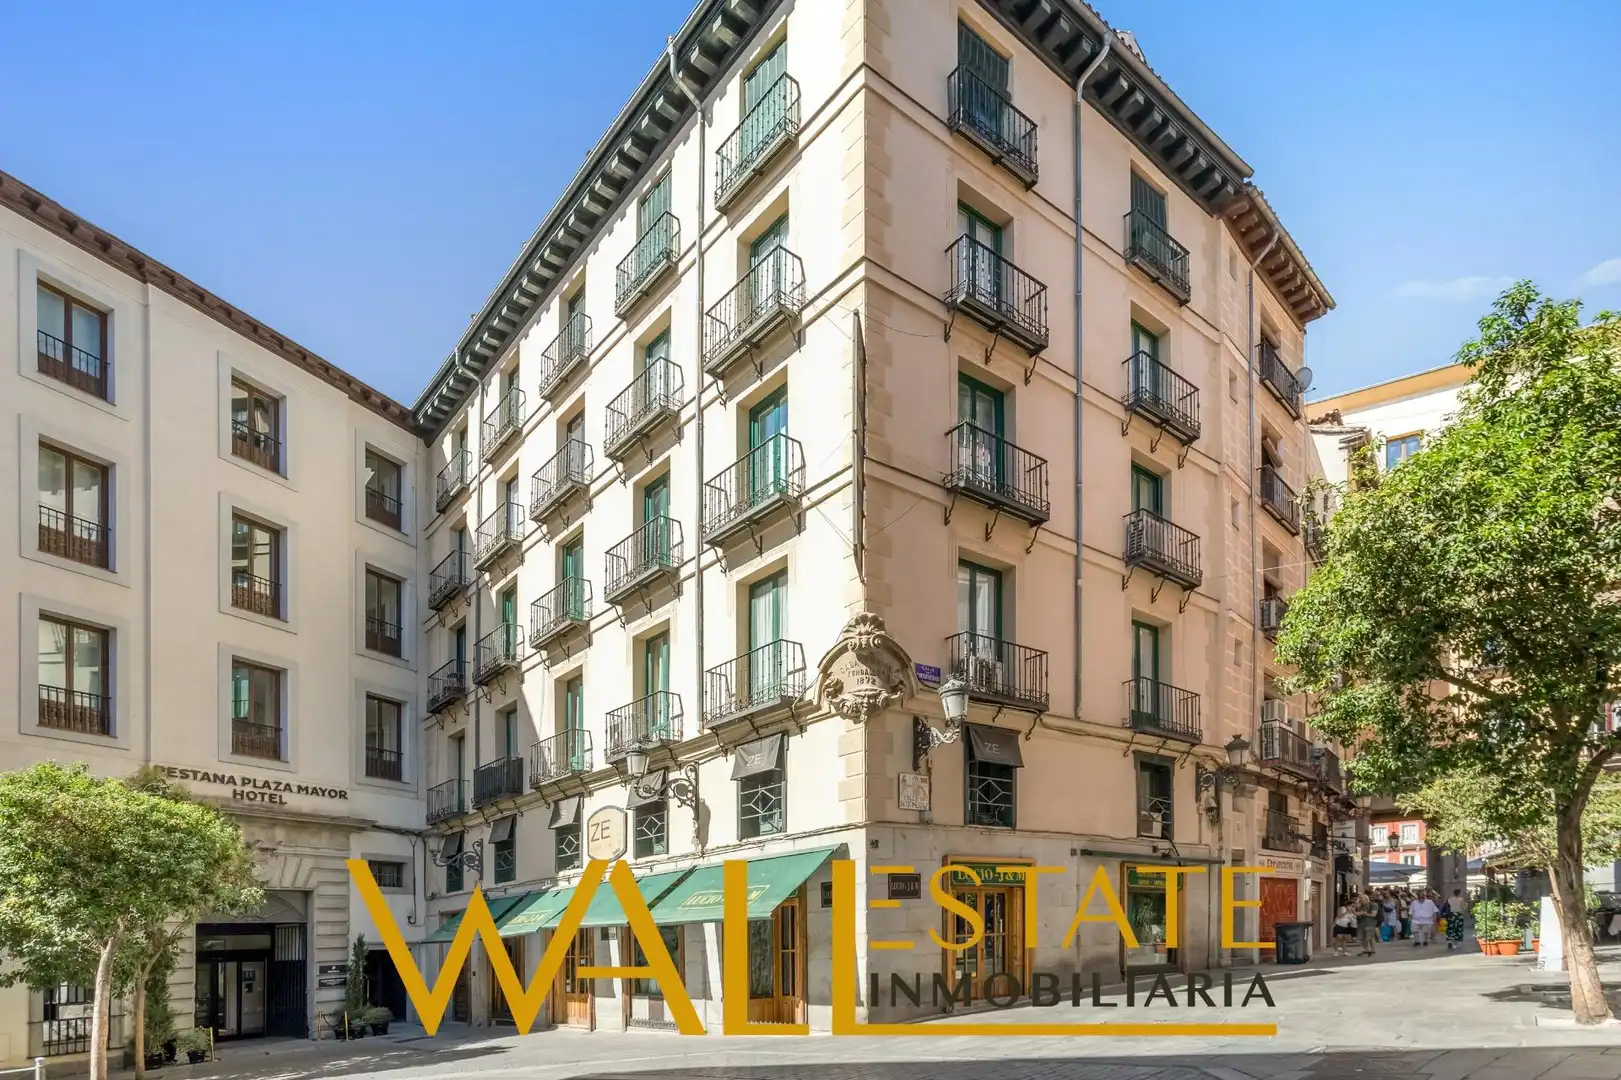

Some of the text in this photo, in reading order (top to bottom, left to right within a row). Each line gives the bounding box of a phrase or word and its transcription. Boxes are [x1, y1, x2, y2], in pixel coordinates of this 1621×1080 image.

[856, 676, 877, 686] 1872
[984, 742, 1001, 755] ZE
[746, 752, 763, 767] ZE
[241, 776, 293, 793] PLAZA
[296, 784, 349, 800] MAYOR
[232, 788, 288, 805] HOTEL
[590, 819, 611, 842] ZE
